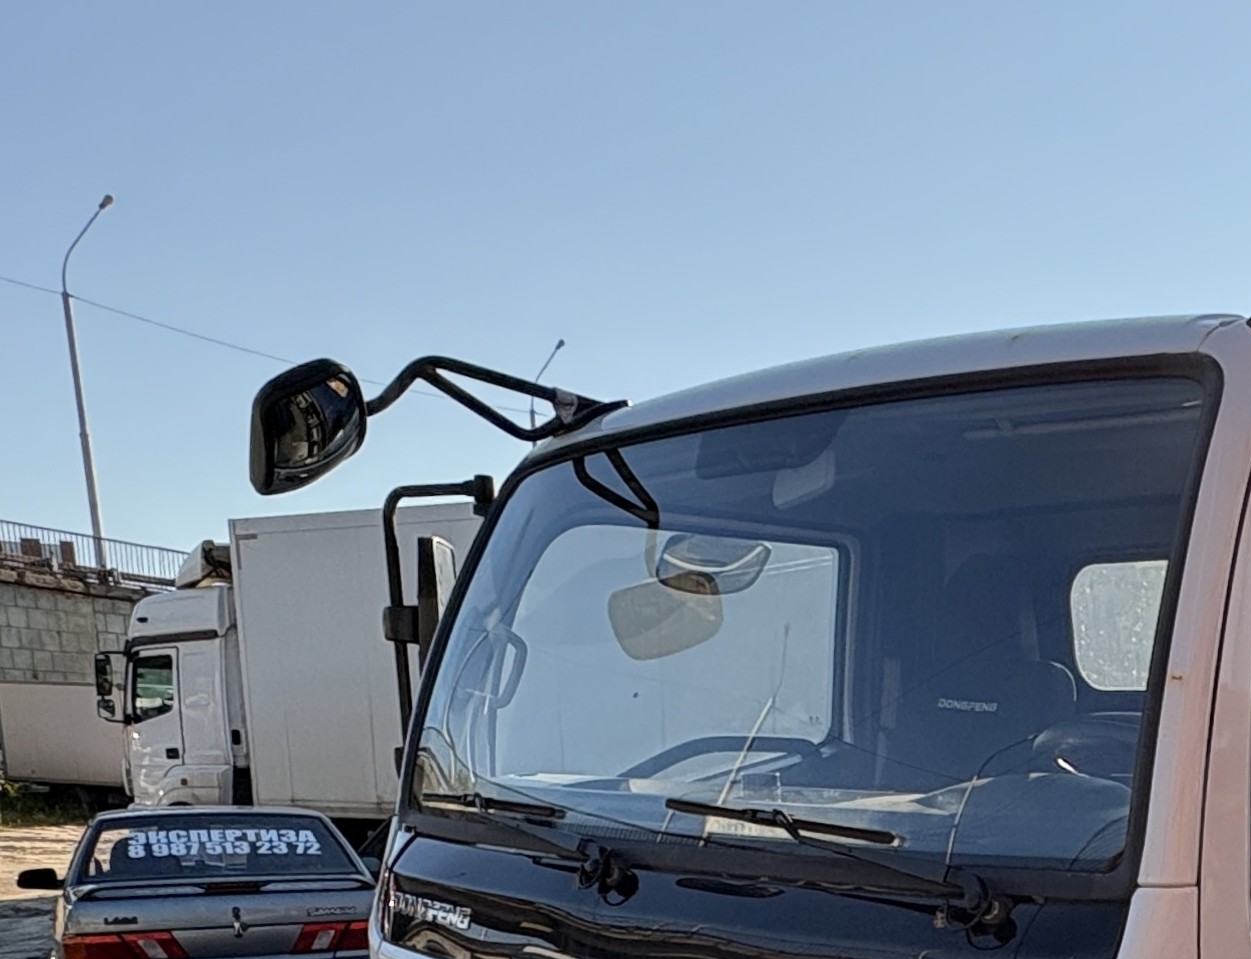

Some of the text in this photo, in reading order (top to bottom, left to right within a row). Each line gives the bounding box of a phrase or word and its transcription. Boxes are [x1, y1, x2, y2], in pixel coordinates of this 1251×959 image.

[937, 698, 998, 712] DONGFENG
[127, 829, 318, 845] ЭКСПЕРТИЗА
[128, 842, 322, 859] 8 987 513 23 72
